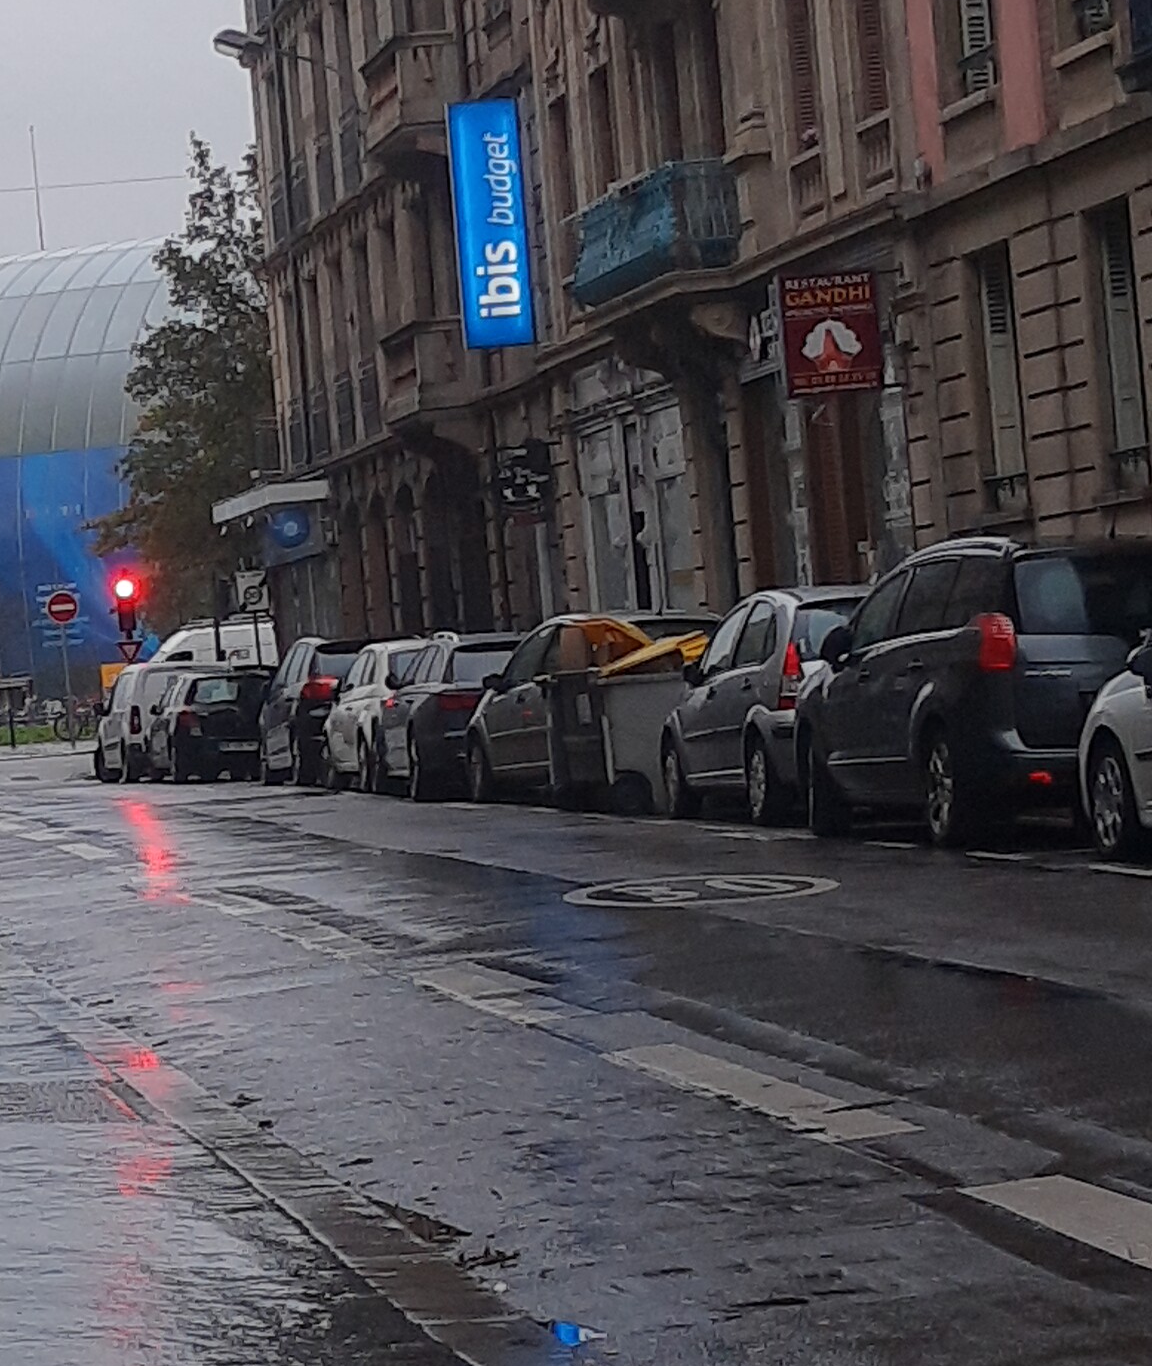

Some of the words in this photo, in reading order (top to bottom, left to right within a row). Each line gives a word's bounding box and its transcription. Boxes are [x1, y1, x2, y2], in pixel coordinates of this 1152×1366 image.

[483, 132, 518, 226] budget
[476, 239, 522, 319] ibis
[785, 273, 870, 290] RESTAURANT
[785, 285, 870, 306] GANDHI
